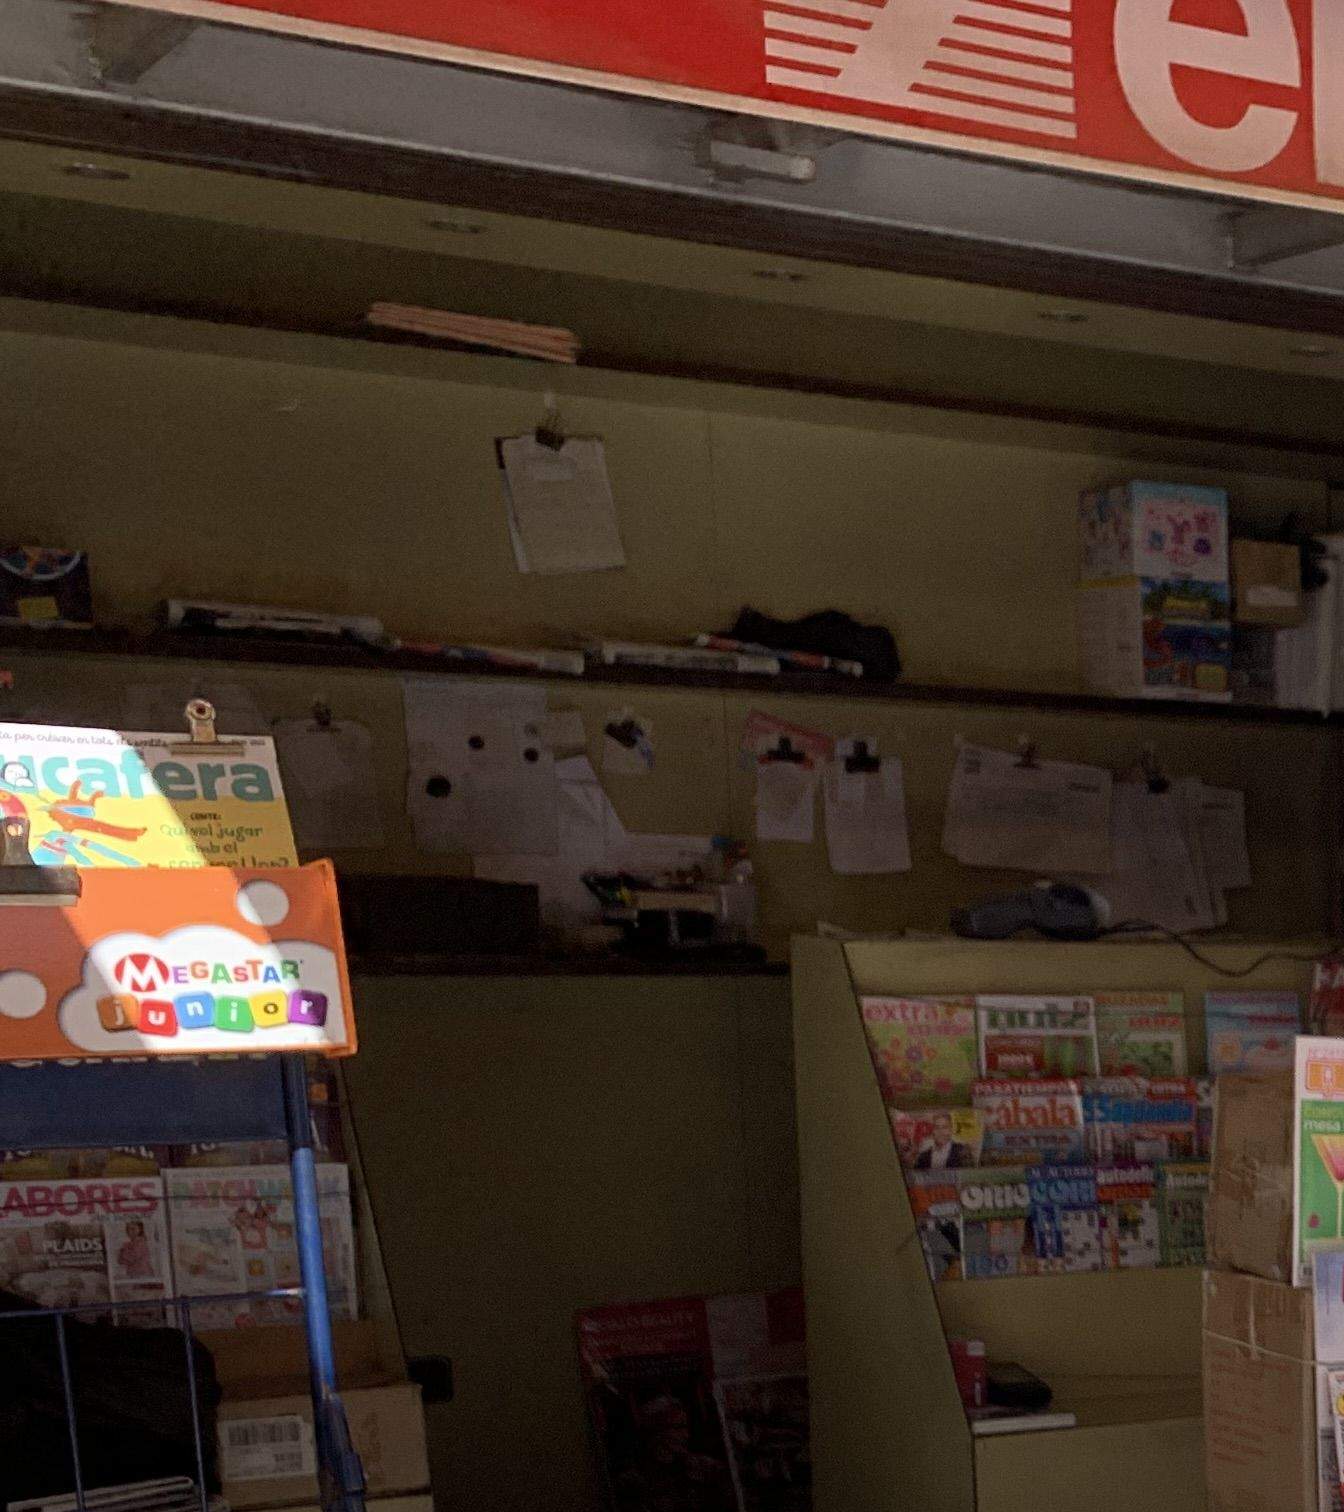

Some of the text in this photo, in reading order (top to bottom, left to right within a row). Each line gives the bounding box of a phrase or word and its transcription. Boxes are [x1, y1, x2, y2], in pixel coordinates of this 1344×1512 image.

[115, 953, 301, 993] MEGASTAR
[106, 995, 320, 1031] junior
[42, 1239, 103, 1253] PLAIDS
